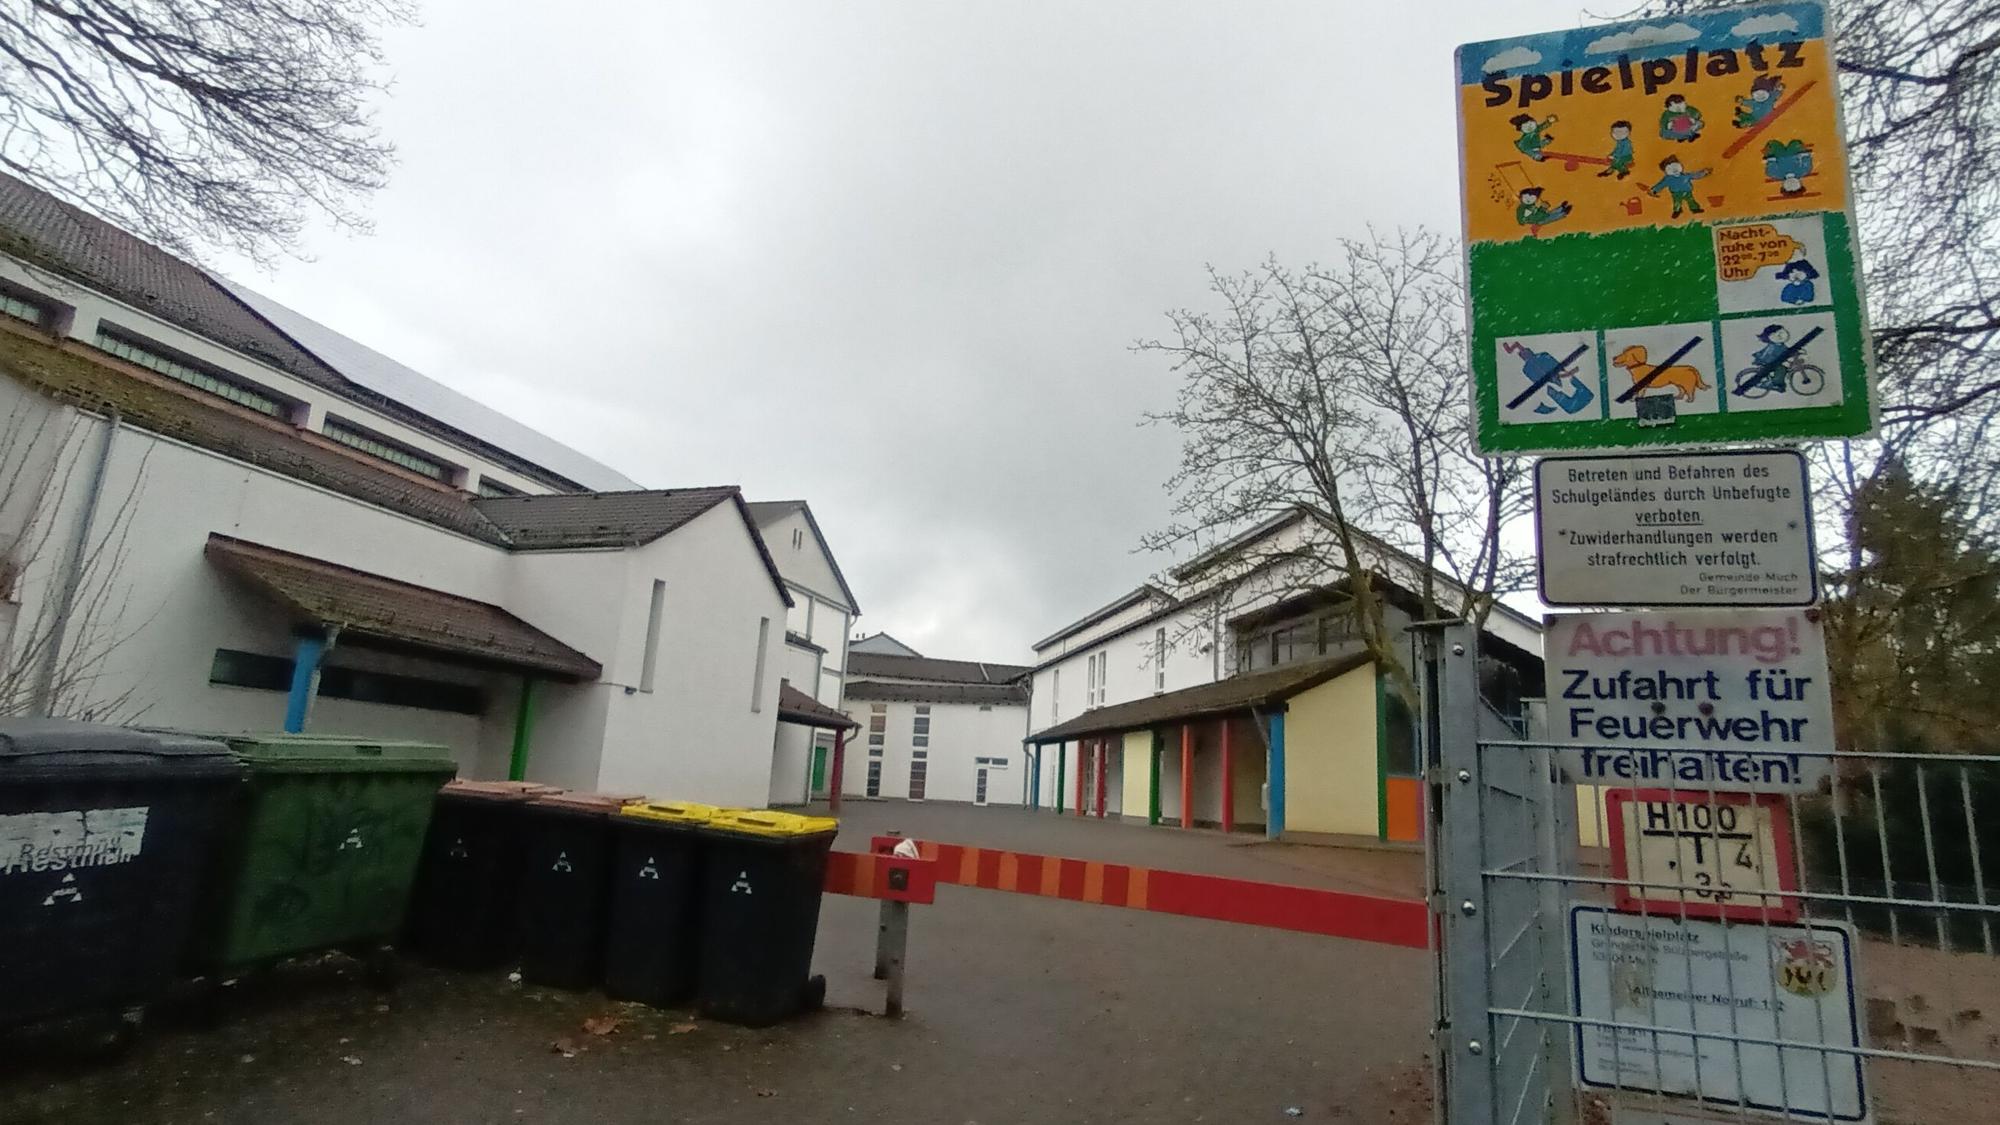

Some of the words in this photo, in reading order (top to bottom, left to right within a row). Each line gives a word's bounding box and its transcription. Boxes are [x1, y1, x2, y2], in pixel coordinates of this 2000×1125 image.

[1482, 40, 1806, 109] Spielplatz
[1720, 227, 1770, 241] Nacht-
[1721, 242, 1755, 254] ruhe
[1760, 239, 1788, 250] von
[1723, 267, 1750, 278] Uhr
[1567, 467, 1629, 483] Betreten
[1635, 465, 1662, 481] und
[1668, 463, 1736, 480] Befahren
[1742, 463, 1770, 479] des
[1552, 488, 1656, 506] Schulgeländes
[1664, 486, 1706, 502] durch
[1713, 485, 1791, 501] Unbefugte
[1568, 530, 1713, 548] Zuwiderhandlungen
[1721, 528, 1778, 544] werden
[1587, 551, 1688, 567] strafrechtlich
[1695, 550, 1761, 569] verfolgt.
[1699, 572, 1760, 582] Gemeinde
[1766, 572, 1798, 582] Much
[1680, 585, 1700, 595] Der
[1567, 616, 1801, 663] Achtung!
[1562, 669, 1723, 701] Zufahrt
[1745, 668, 1812, 701] für
[1569, 707, 1809, 743] Feuerwehr
[1582, 748, 1802, 784] freihaten!
[1647, 801, 1736, 832] H100
